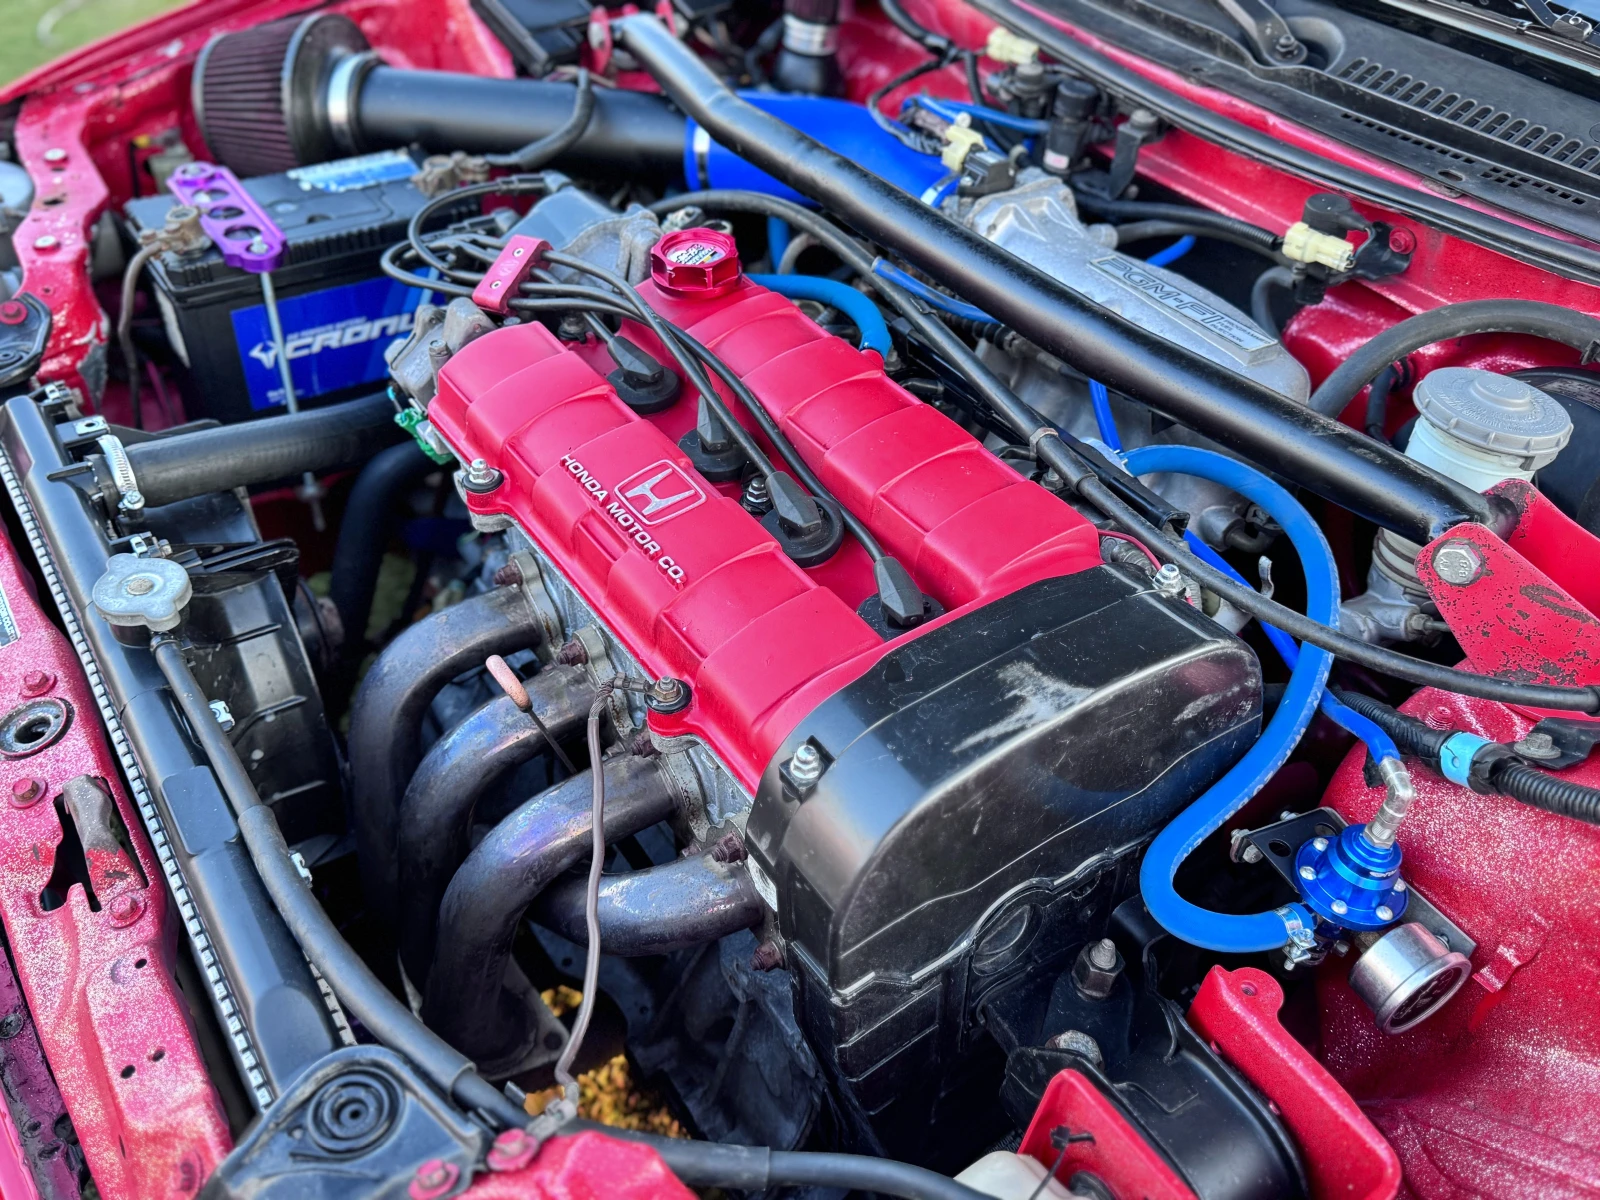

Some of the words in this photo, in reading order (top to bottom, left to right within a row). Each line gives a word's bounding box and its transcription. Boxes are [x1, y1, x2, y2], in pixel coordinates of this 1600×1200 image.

[1098, 257, 1222, 325] PGM-FI
[560, 453, 609, 503] HONDA
[606, 501, 661, 556] MOTOR
[658, 555, 685, 584] CO.
